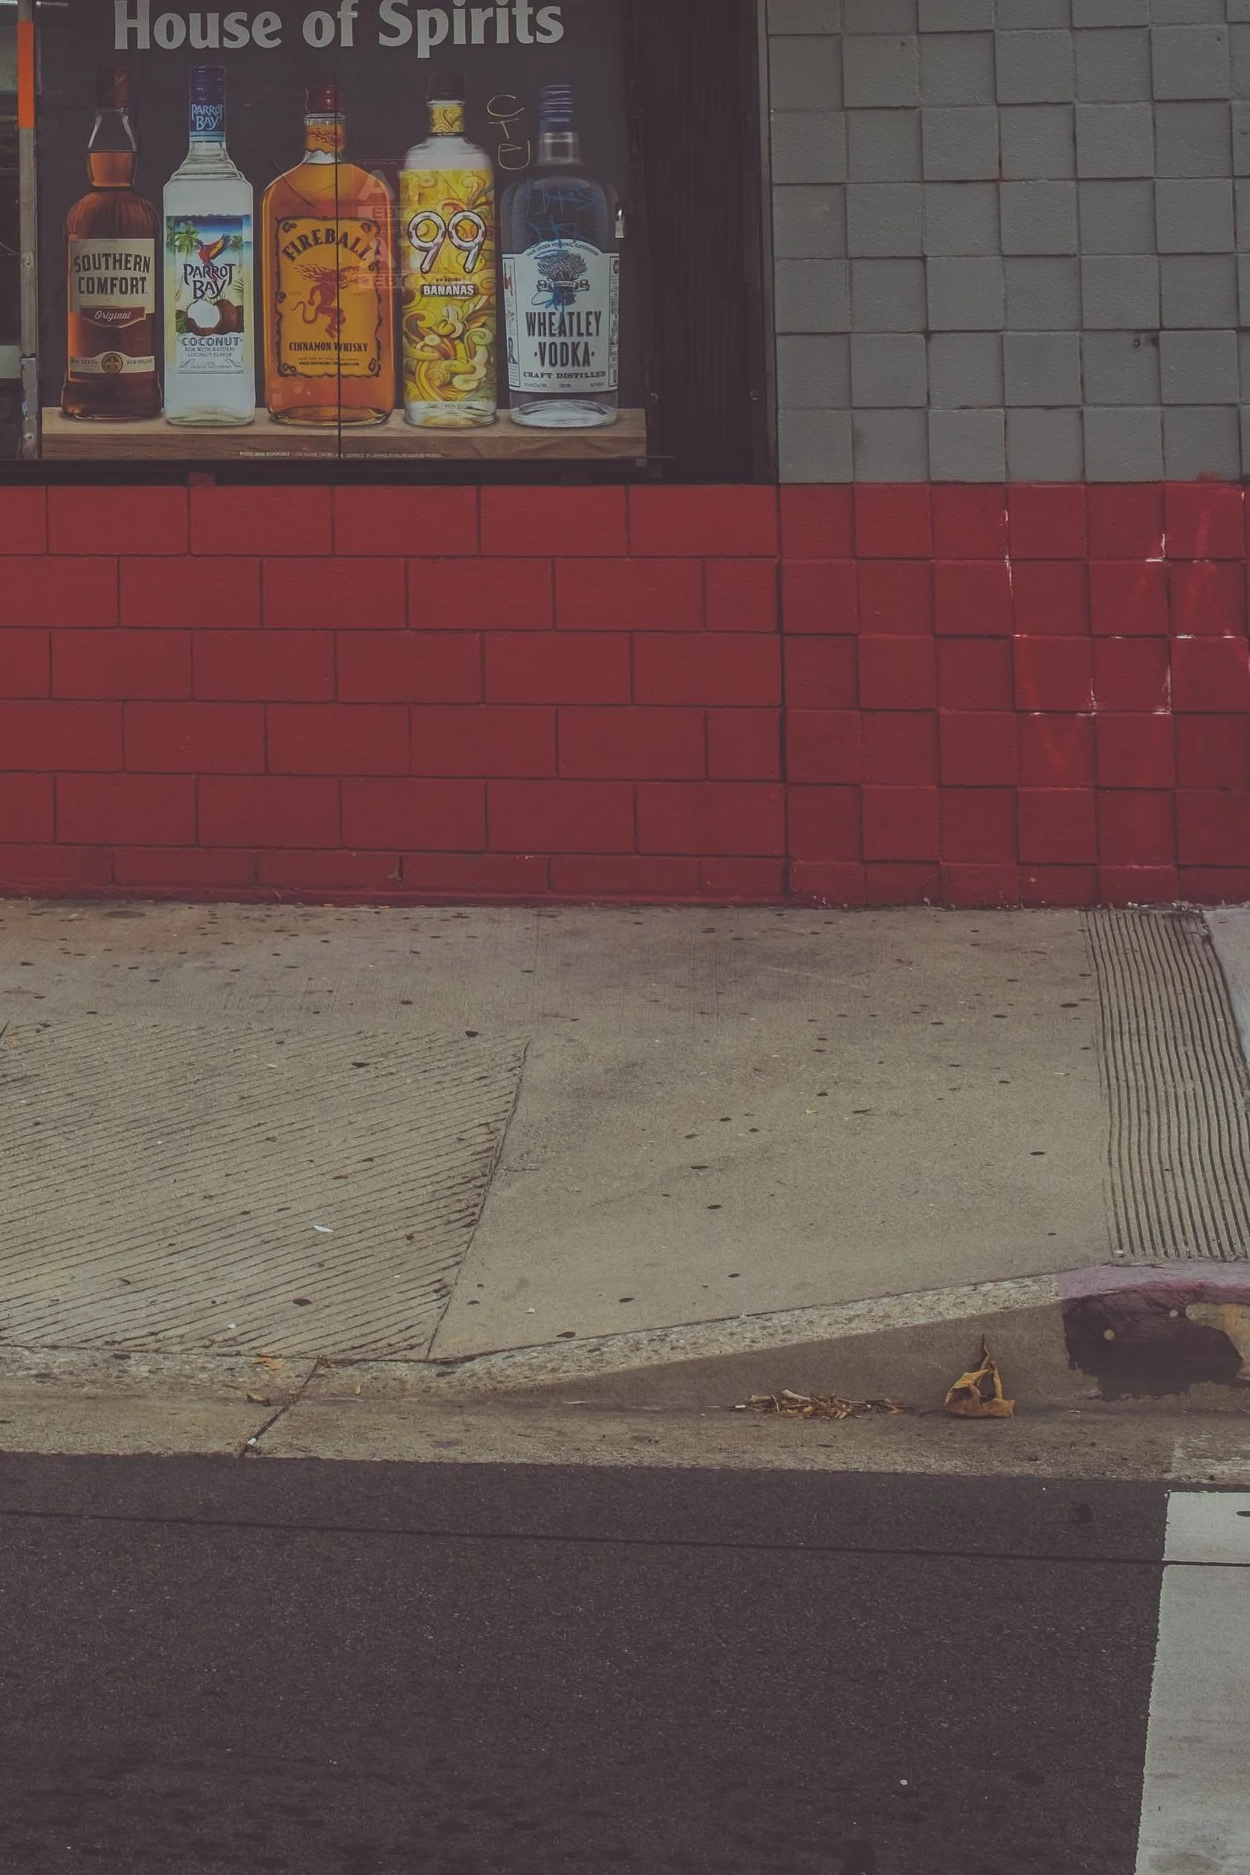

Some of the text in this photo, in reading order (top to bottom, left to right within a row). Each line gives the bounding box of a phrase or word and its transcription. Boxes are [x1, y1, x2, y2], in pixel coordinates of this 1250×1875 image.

[191, 104, 224, 122] PARROT
[196, 115, 220, 131] BAY
[282, 227, 372, 263] FIREBALL
[407, 210, 487, 274] 99
[73, 252, 151, 274] SOUTHERN
[183, 263, 237, 286] PARROT
[78, 276, 147, 295] COMFORT
[192, 279, 227, 300] BAY
[423, 285, 475, 296] BANANAS
[94, 310, 132, 322] Original
[525, 311, 602, 338] WHEATLEY
[181, 336, 240, 346] COCONUT
[288, 341, 331, 352] CINNAMON
[537, 340, 591, 367] VODKA
[523, 371, 553, 379] CRAFT
